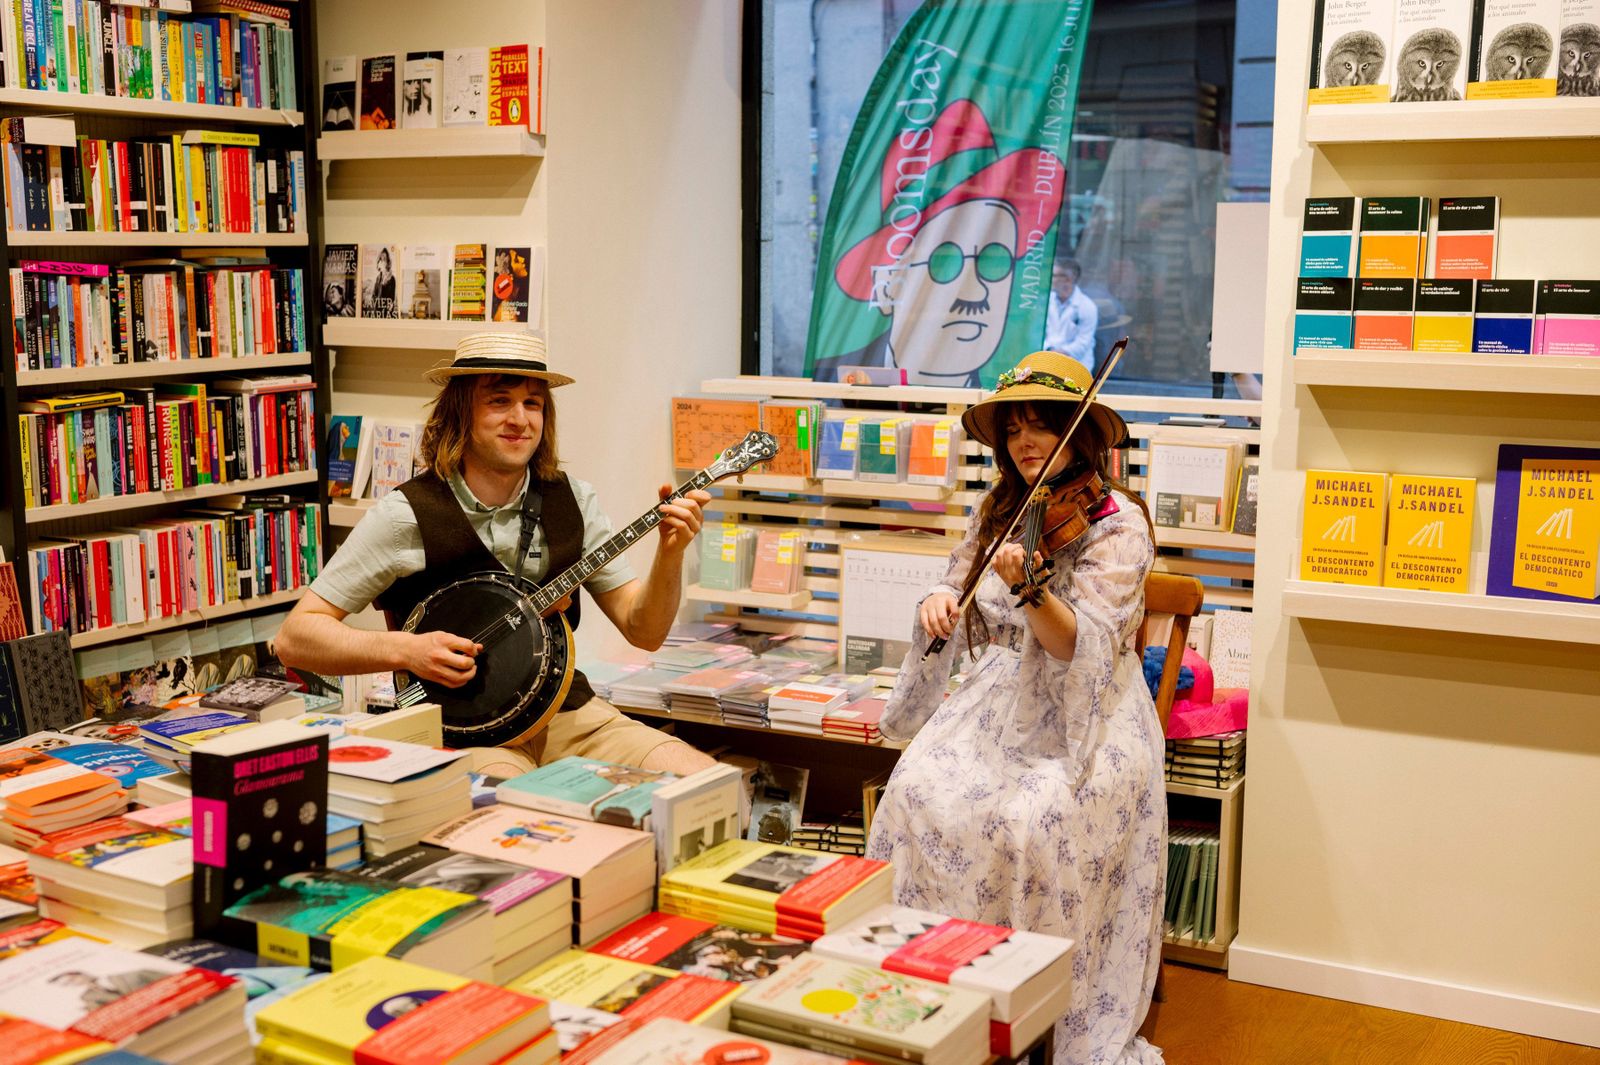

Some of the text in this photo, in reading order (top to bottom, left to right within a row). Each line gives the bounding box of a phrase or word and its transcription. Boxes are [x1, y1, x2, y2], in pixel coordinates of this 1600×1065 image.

[1328, 0, 1368, 10] John Berger
[25, 25, 35, 53] CIRCLE
[103, 18, 113, 54] JUNGLE
[502, 60, 527, 74] TEXT
[490, 50, 501, 126] PANISH
[1019, 229, 1046, 310] MADRID
[1034, 114, 1062, 195] DUBLÍN
[1057, 35, 1075, 52] 16
[327, 250, 355, 261] JAVIER
[324, 261, 357, 273] MARÍAS
[362, 297, 393, 309] JAVIER
[148, 413, 156, 434] WELSH
[152, 467, 160, 489] KNIVES
[164, 449, 174, 491] WELSH
[1531, 468, 1592, 483] MICHAEL
[1316, 479, 1373, 493] MICHAEL
[1402, 484, 1462, 498] MICHAEL
[1318, 557, 1374, 568] DESCONTENTO
[1520, 552, 1591, 569] EL DESCONTENTO
[1312, 565, 1368, 576] DEMOCRÁTICO
[1403, 563, 1462, 574] DESCONTENTO
[1525, 563, 1583, 579] DEMOCRÁTICO
[1396, 572, 1455, 584] DEMOCRÁTICO
[296, 744, 319, 764] ELLIS
